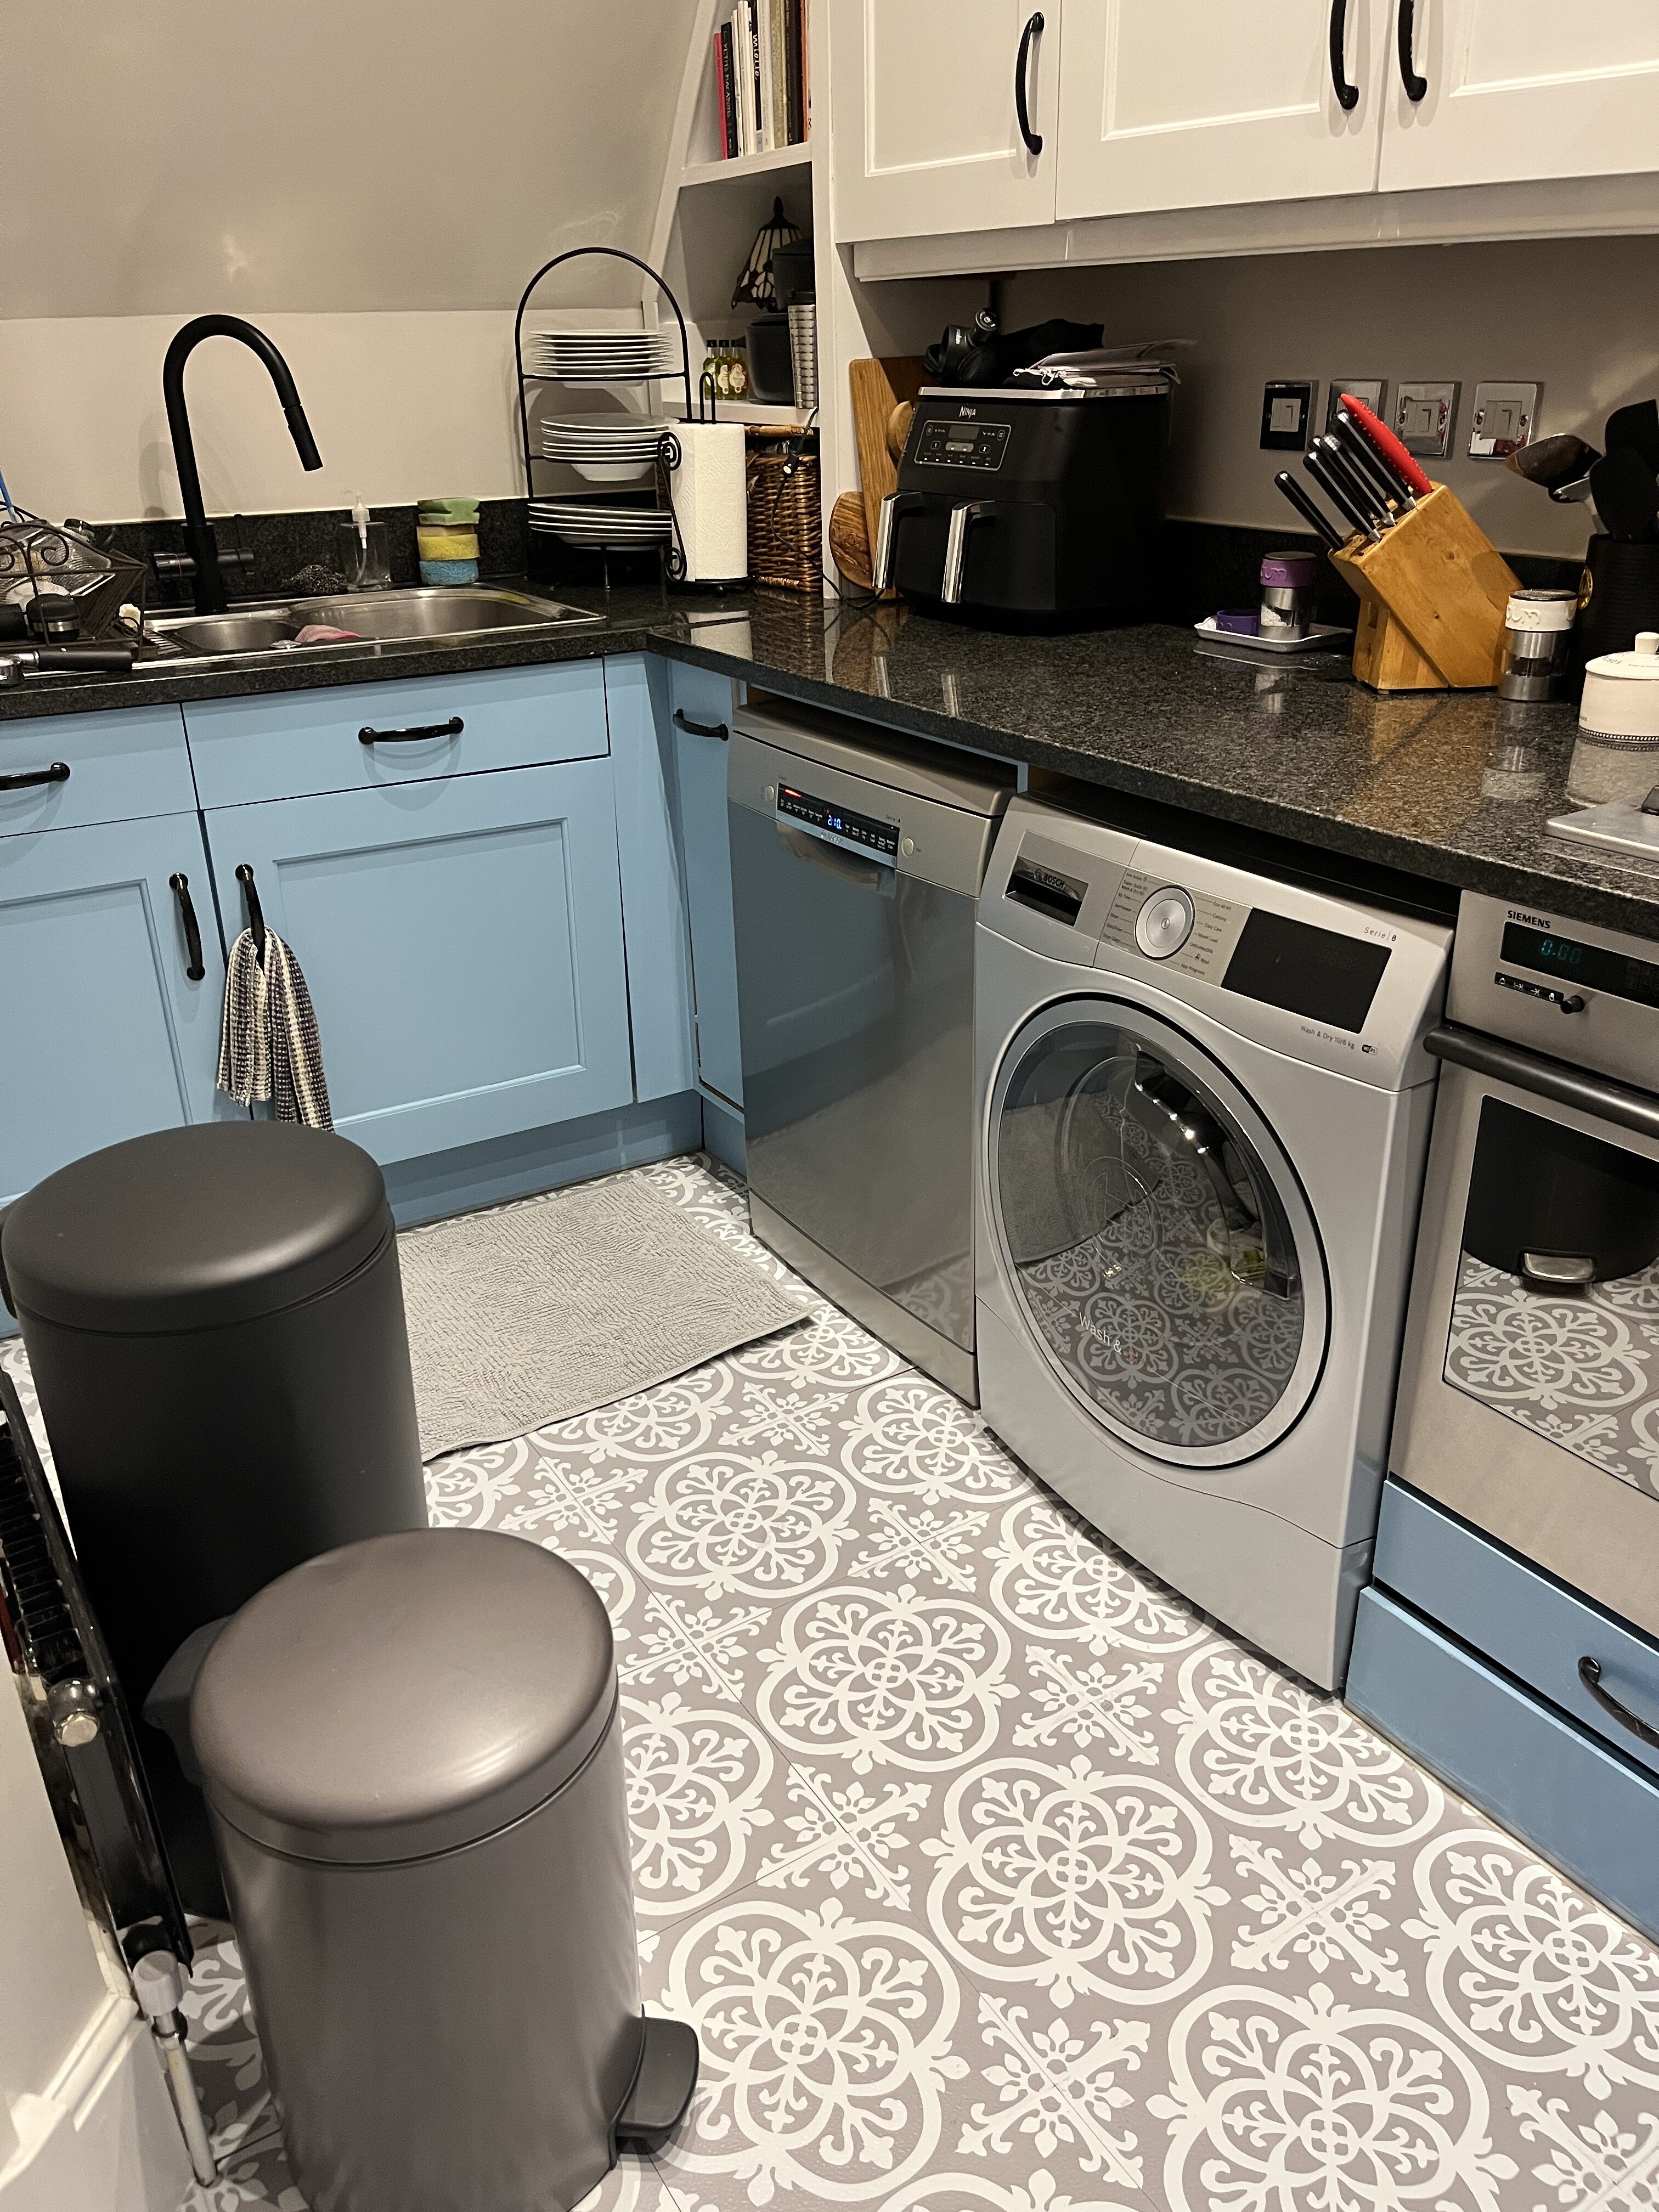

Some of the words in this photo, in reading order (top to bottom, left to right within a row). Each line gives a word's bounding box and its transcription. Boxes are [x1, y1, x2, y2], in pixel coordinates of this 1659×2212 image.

[958, 405, 976, 419] NINJA
[1042, 873, 1065, 889] BOSCH
[1507, 910, 1550, 929] SIEMENS
[1364, 927, 1386, 939] Serie
[1300, 1025, 1315, 1035] Wash
[1323, 1032, 1334, 1043] Dry
[1347, 1041, 1355, 1049] kg
[1079, 1312, 1110, 1346] Wash
[1113, 1339, 1122, 1356] &
